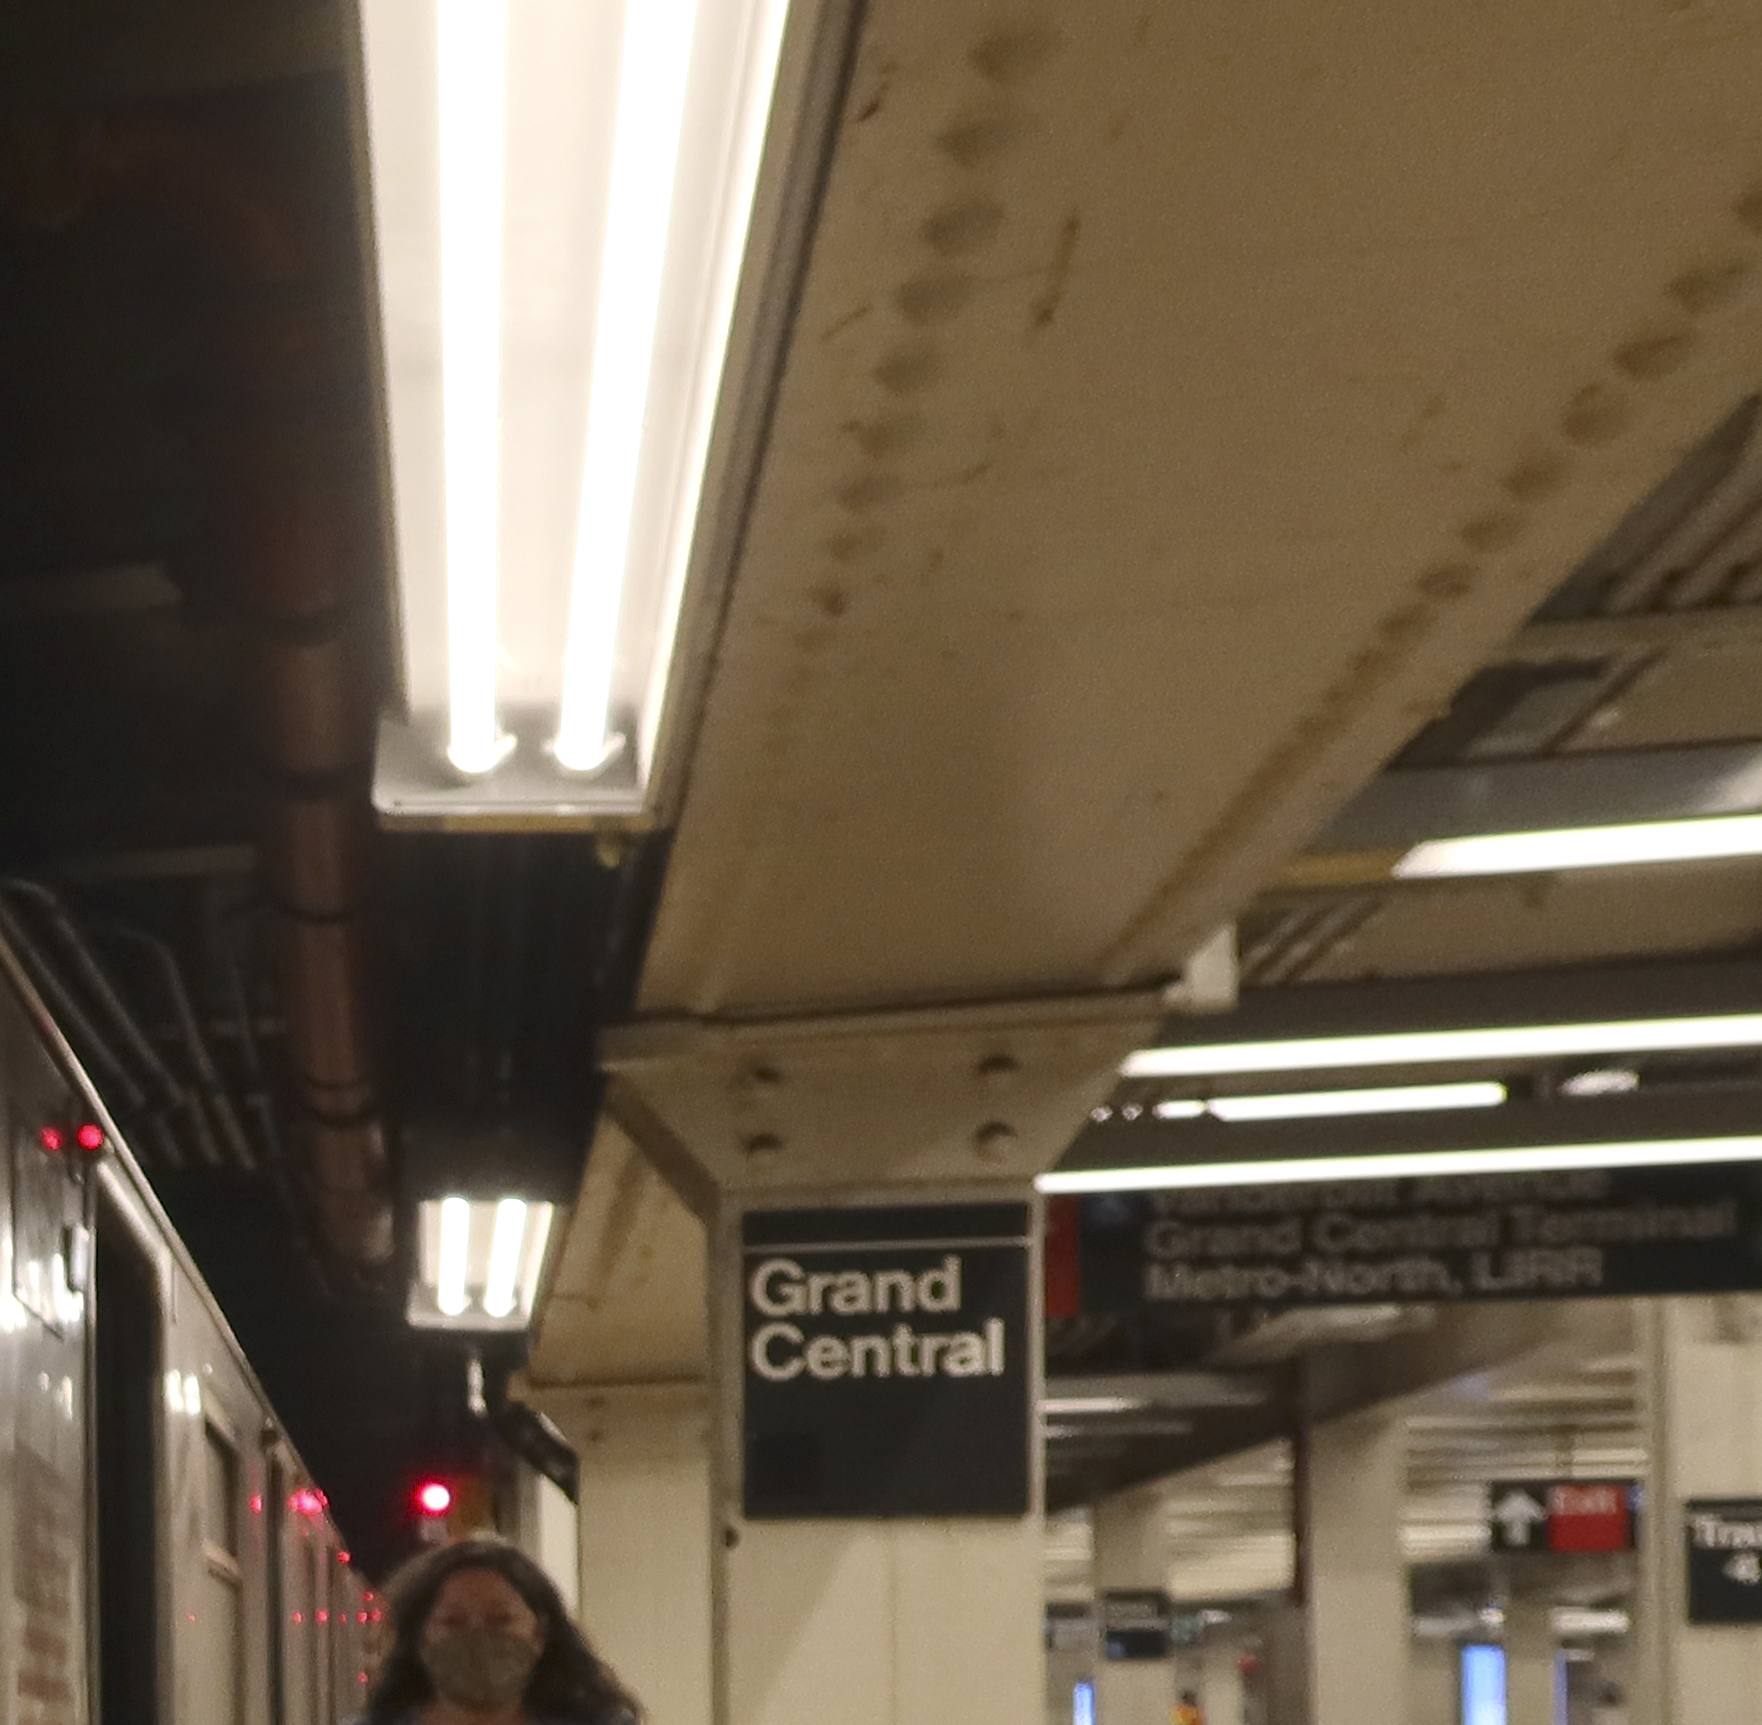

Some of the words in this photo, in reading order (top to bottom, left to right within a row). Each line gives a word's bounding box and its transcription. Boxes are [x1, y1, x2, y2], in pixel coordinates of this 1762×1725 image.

[1146, 1220, 1302, 1258] Grand
[1312, 1209, 1500, 1254] Central
[749, 1253, 963, 1318] Grand
[750, 1315, 1006, 1381] Central
